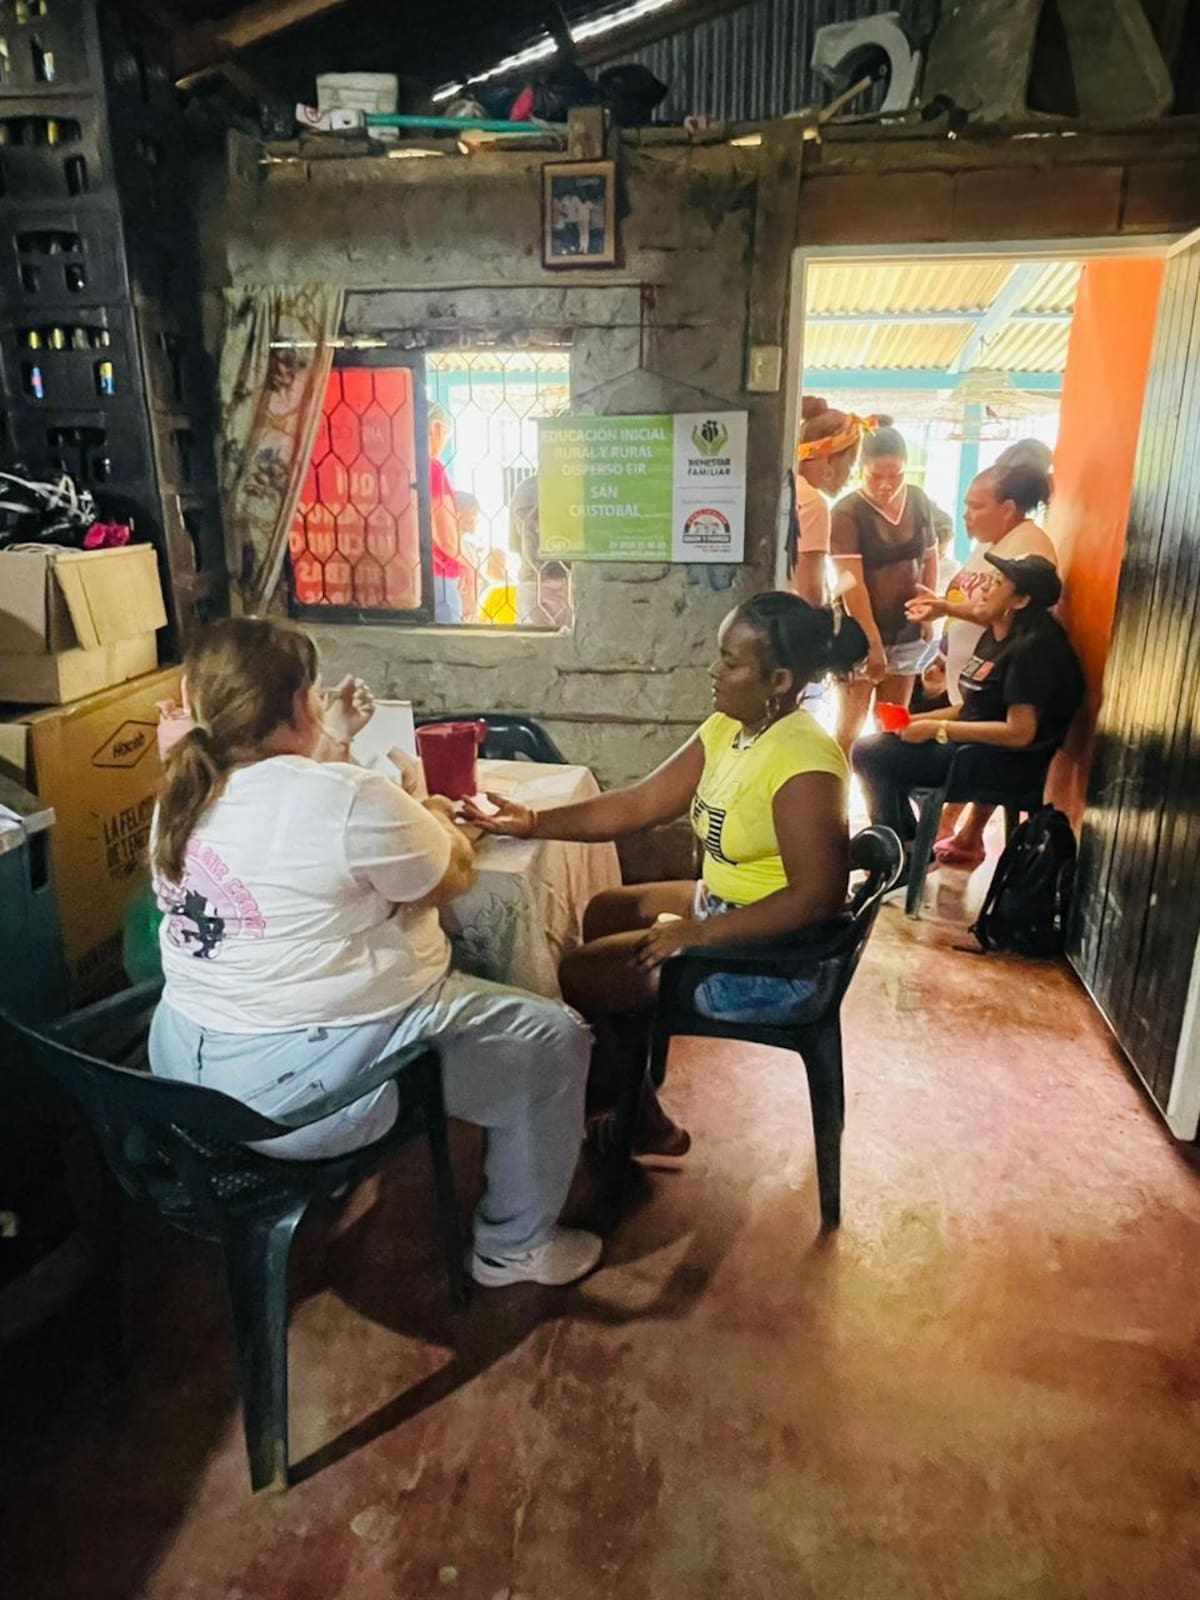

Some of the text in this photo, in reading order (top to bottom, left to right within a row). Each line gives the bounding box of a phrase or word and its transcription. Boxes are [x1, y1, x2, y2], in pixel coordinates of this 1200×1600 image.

[620, 427, 667, 441] INICIAL
[600, 446, 609, 458] Y
[611, 445, 655, 458] RURAL
[561, 461, 647, 476] DISPERSO EIR
[687, 458, 731, 467] BIENESTAR
[687, 467, 731, 477] FAMILIAR
[590, 484, 619, 499] SAN
